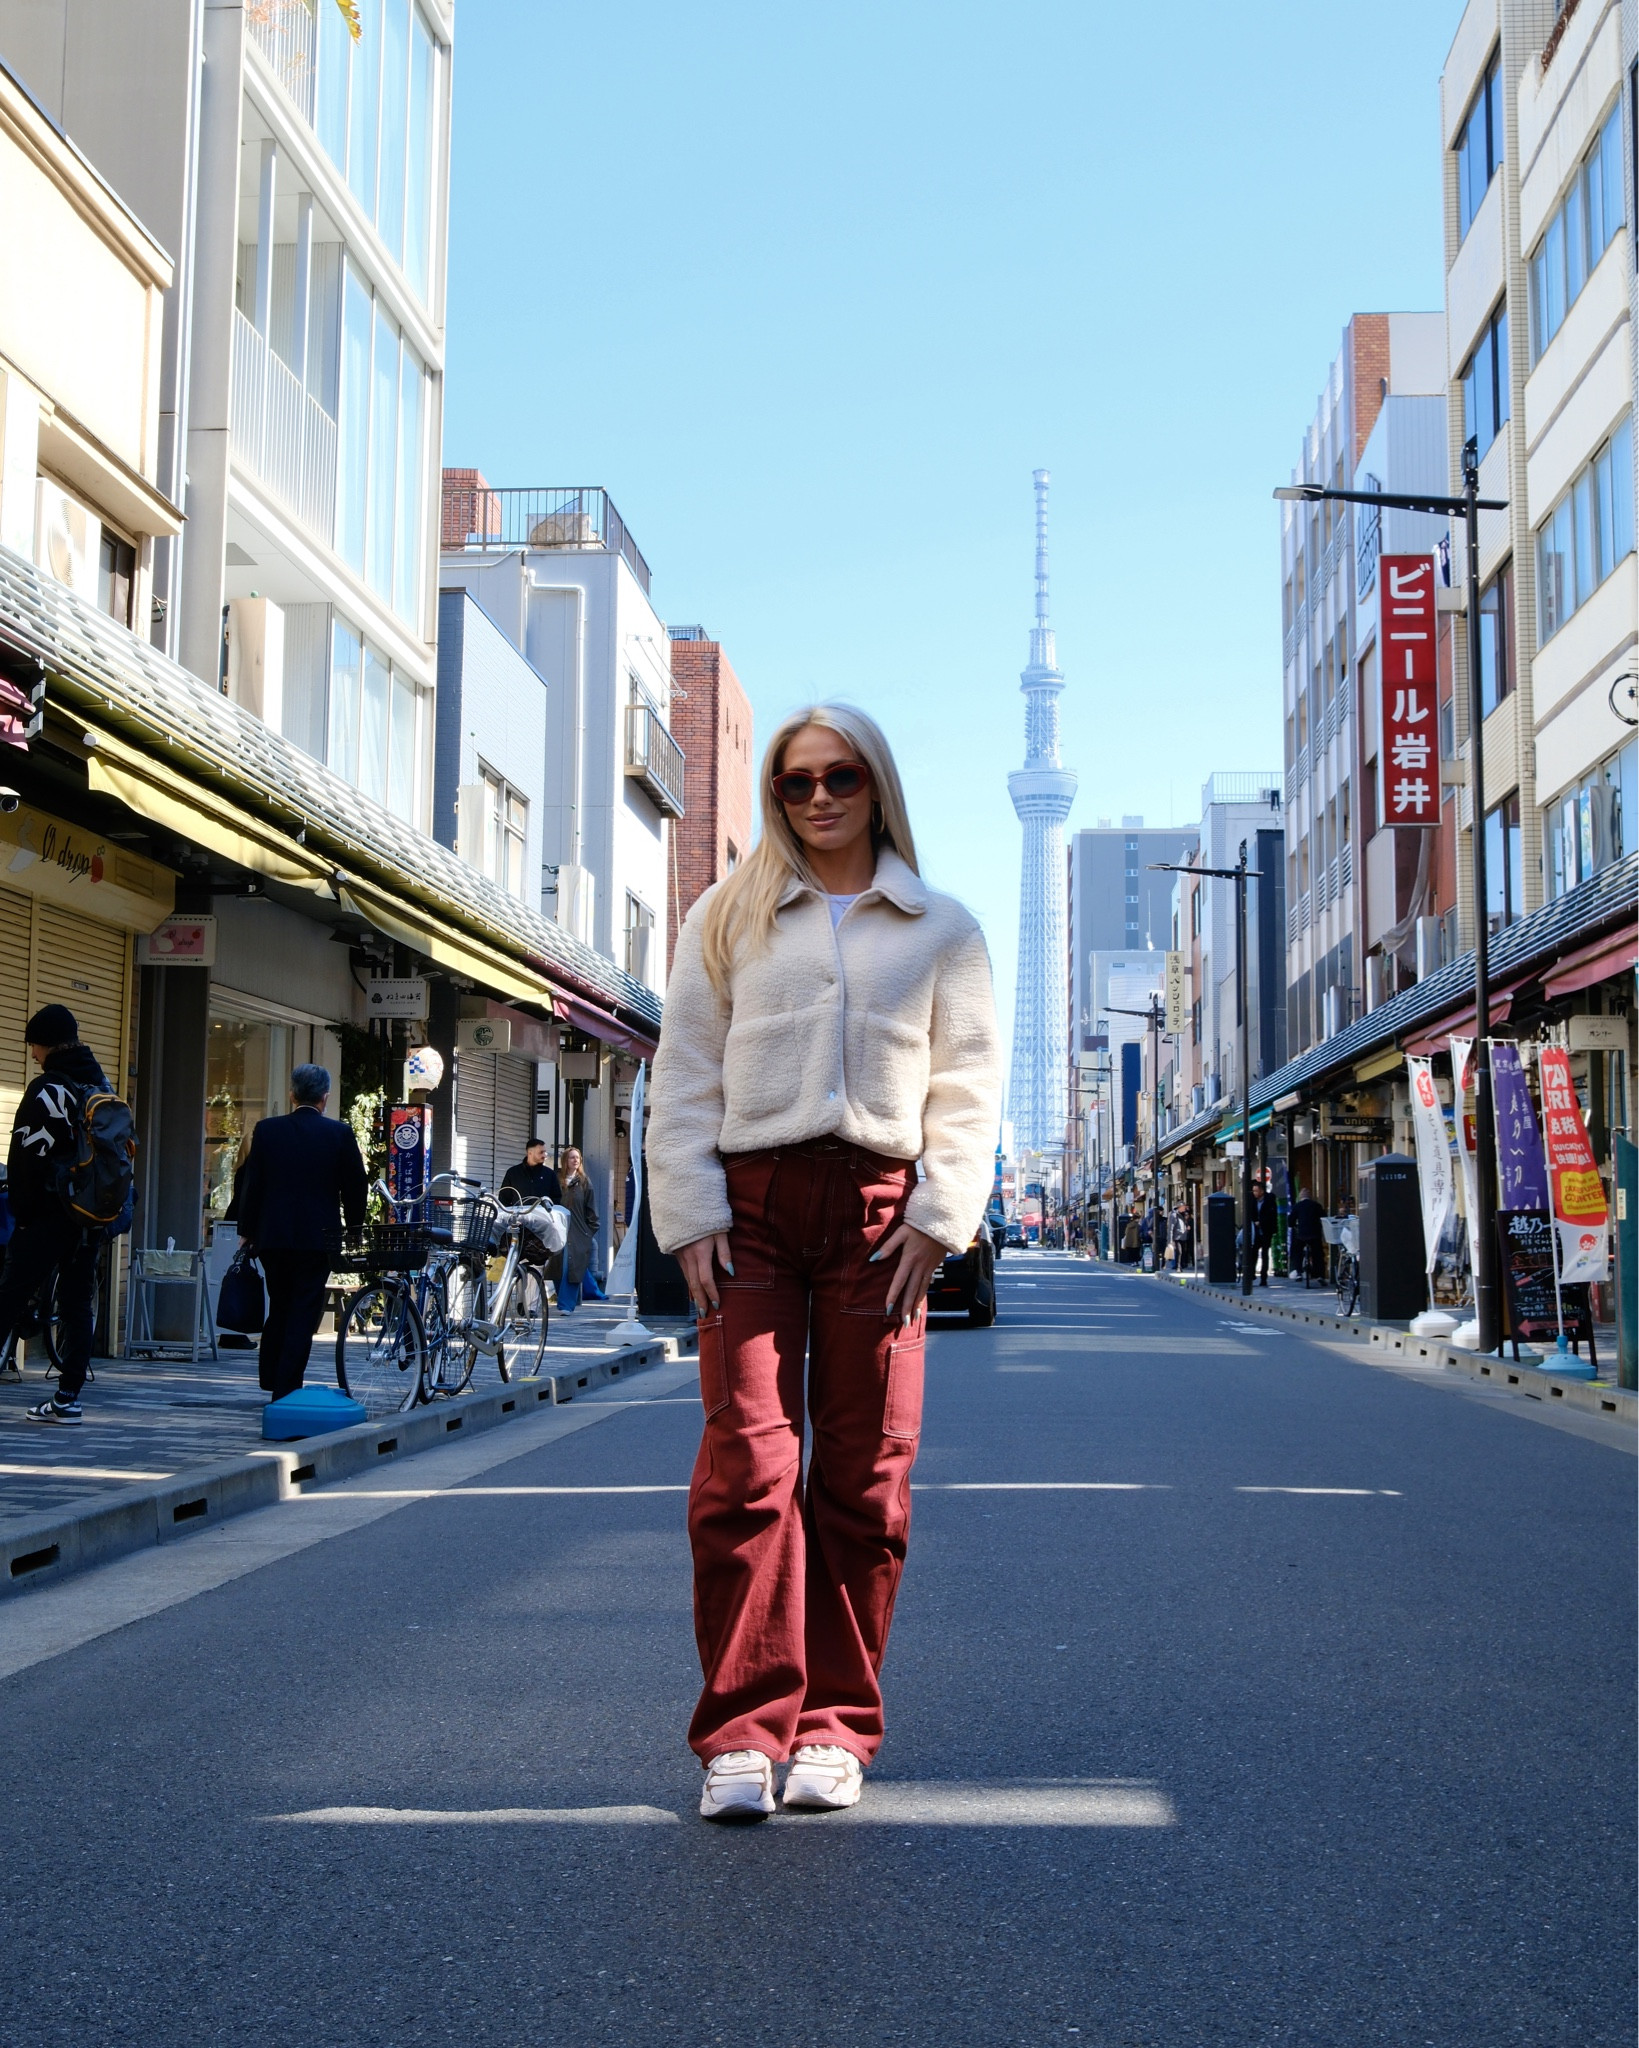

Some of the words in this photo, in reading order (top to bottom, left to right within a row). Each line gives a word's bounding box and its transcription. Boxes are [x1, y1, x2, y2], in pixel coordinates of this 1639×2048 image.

[1389, 562, 1432, 815] ビニール岩井
[1507, 1215, 1560, 1235] 越乃一
